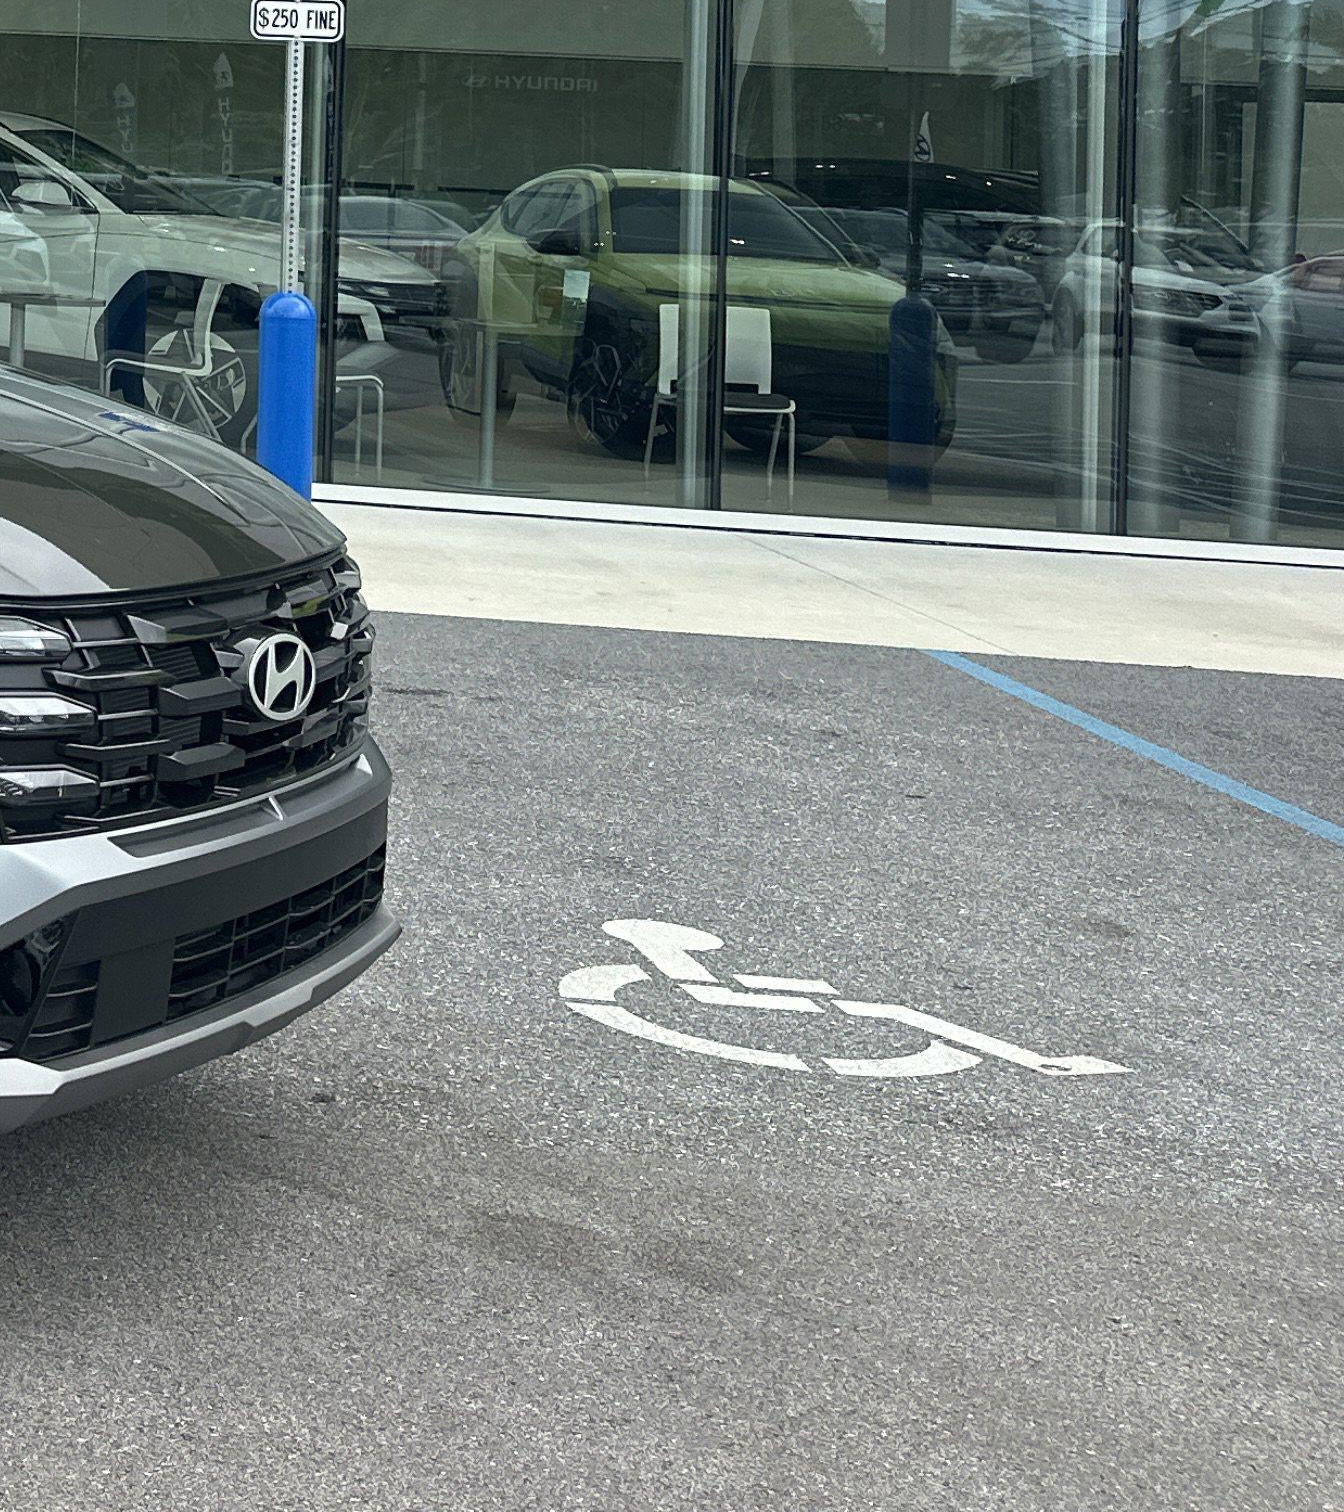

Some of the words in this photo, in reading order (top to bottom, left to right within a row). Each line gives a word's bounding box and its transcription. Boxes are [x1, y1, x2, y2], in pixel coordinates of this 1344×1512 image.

[258, 7, 299, 29] $250
[306, 9, 337, 30] FINE
[494, 75, 599, 92] HYUNDAI
